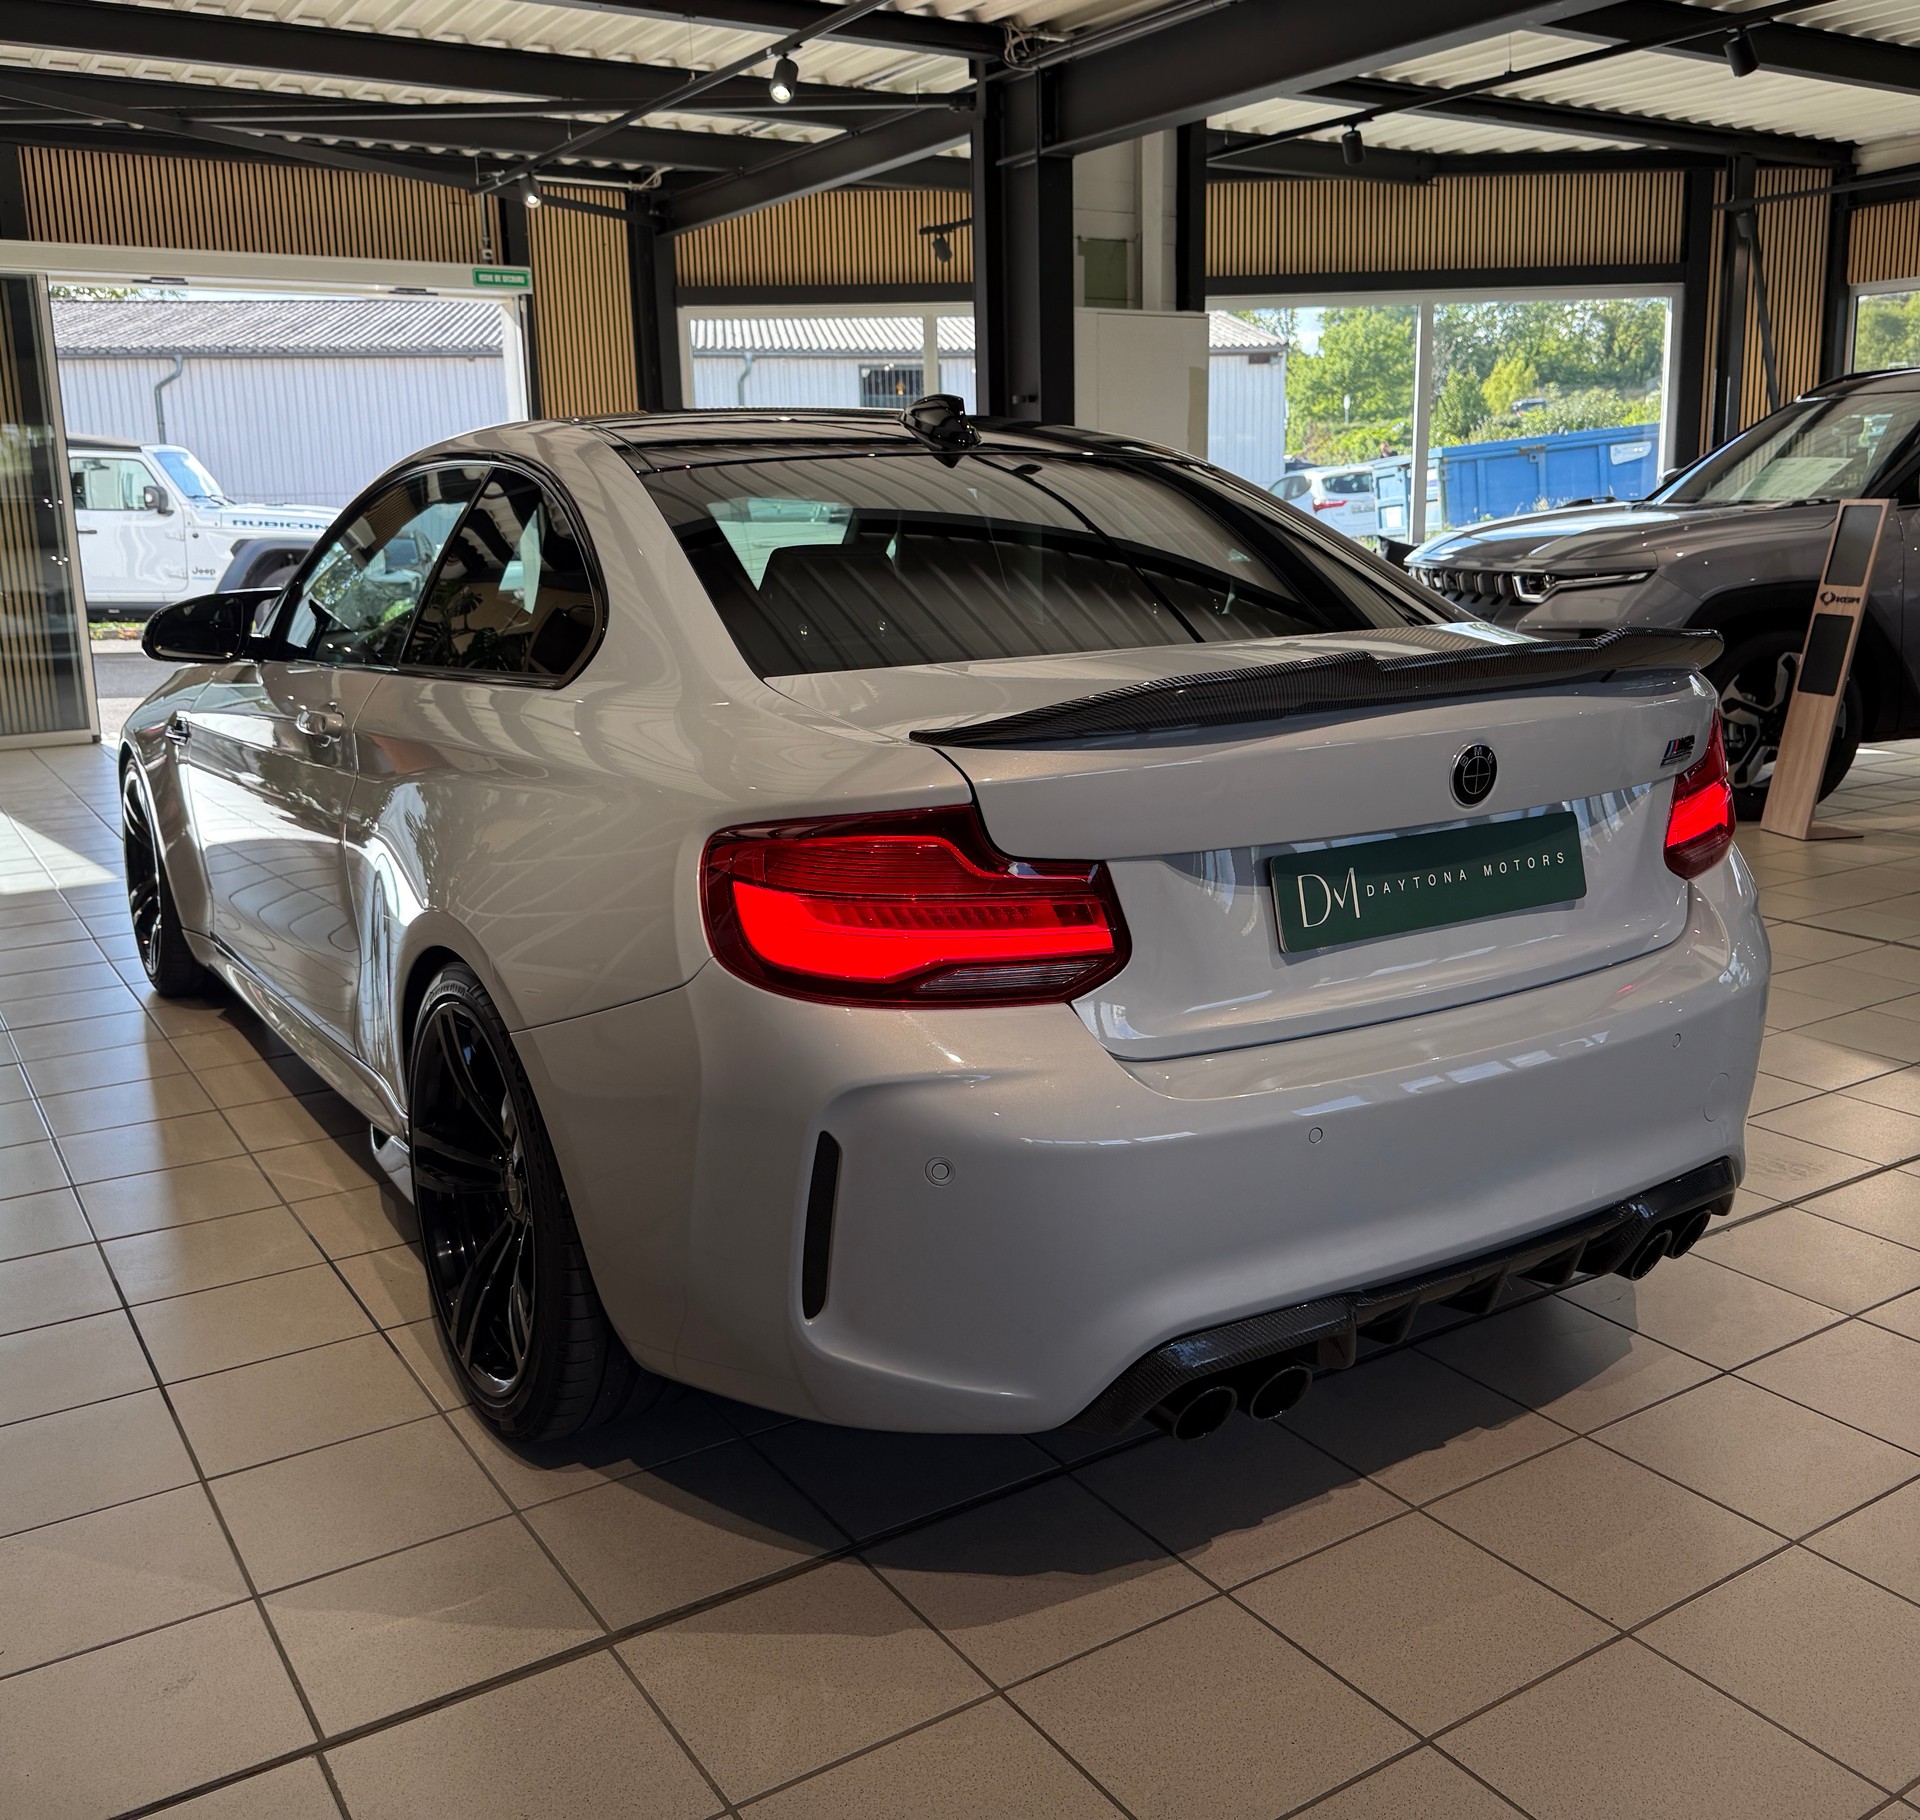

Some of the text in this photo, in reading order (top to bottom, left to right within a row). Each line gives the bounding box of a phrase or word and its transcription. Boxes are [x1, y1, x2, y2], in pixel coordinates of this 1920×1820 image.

[232, 519, 328, 530] RUBICON
[192, 566, 216, 576] Jeep
[1459, 746, 1494, 768] BMW
[1366, 851, 1565, 897] DAYTONA MOTORS
